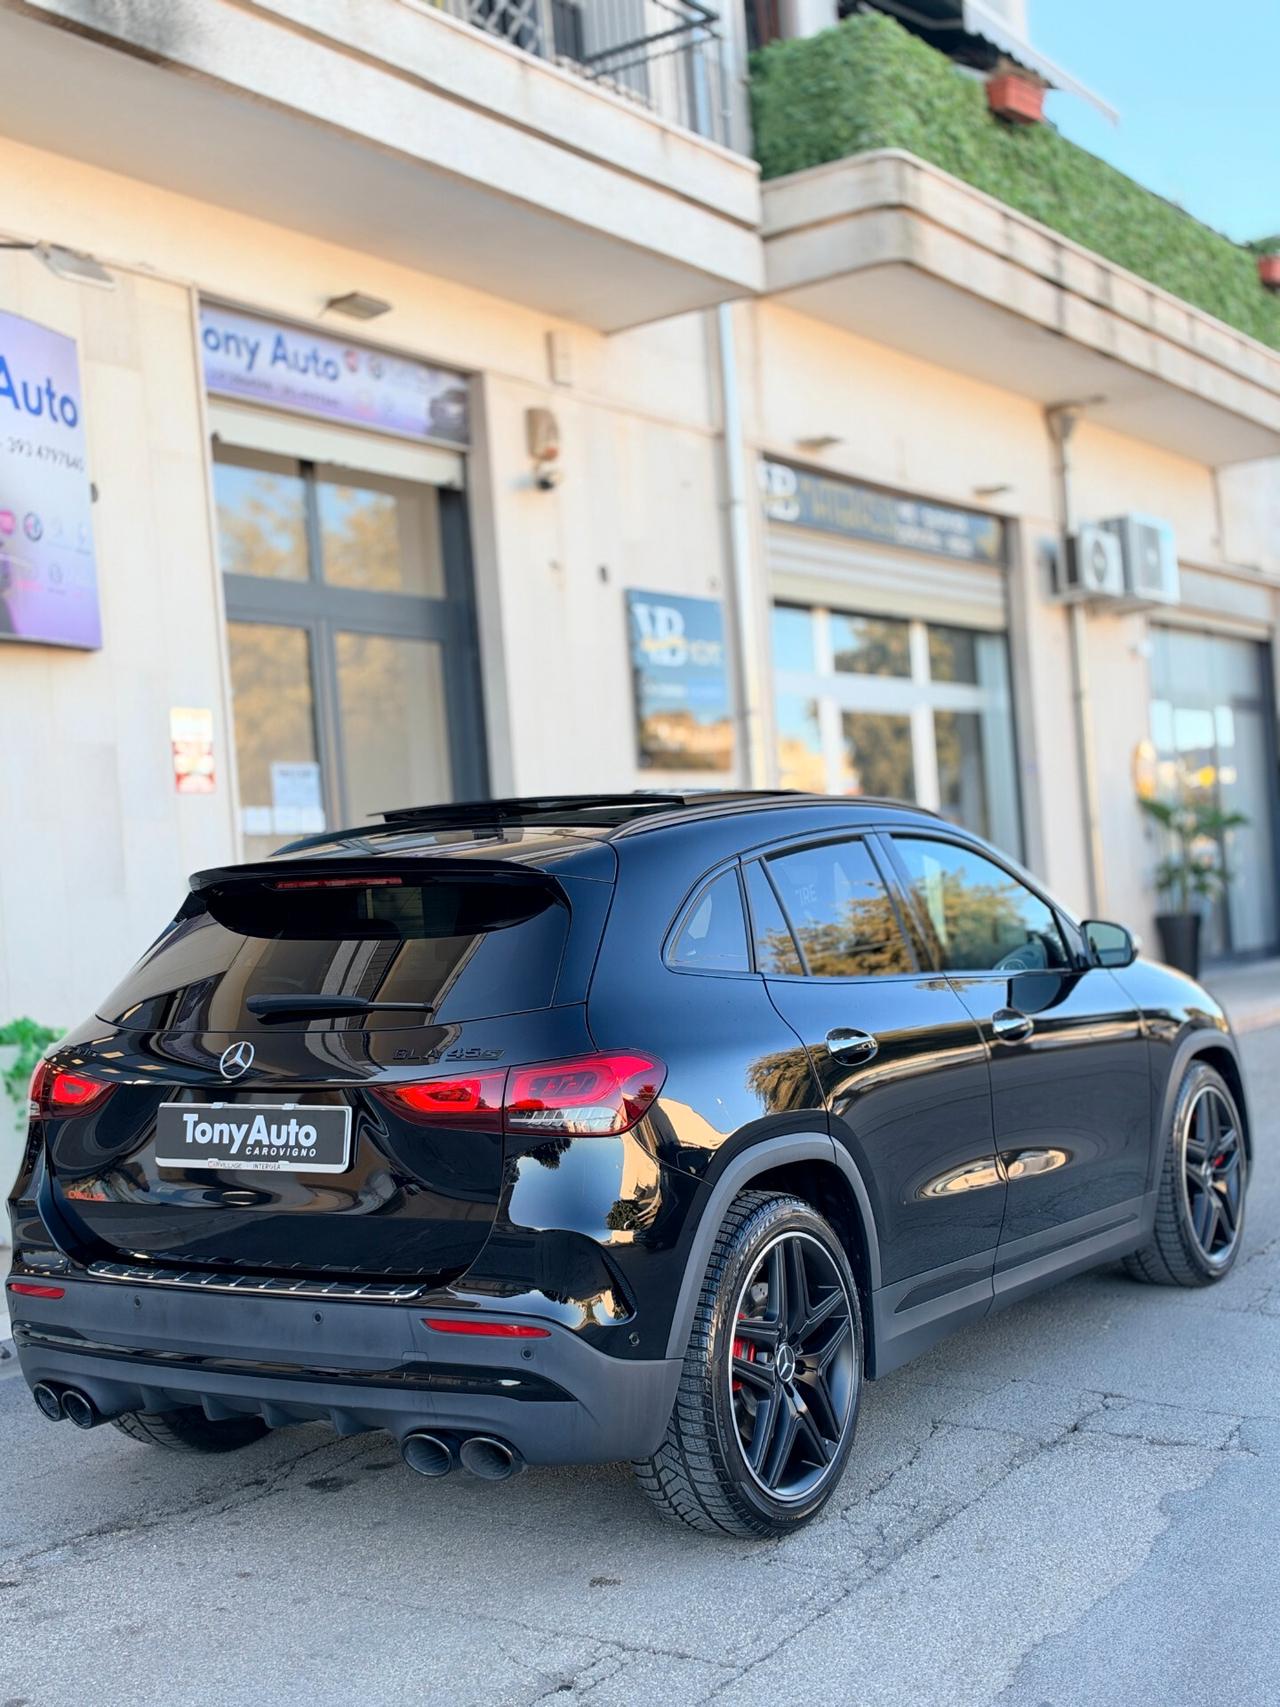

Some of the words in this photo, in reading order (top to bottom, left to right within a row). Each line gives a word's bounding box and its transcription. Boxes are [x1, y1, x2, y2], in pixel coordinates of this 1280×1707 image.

[201, 320, 260, 372] ony
[271, 333, 340, 382] Auto
[245, 1146, 317, 1158] CAROVIGNO
